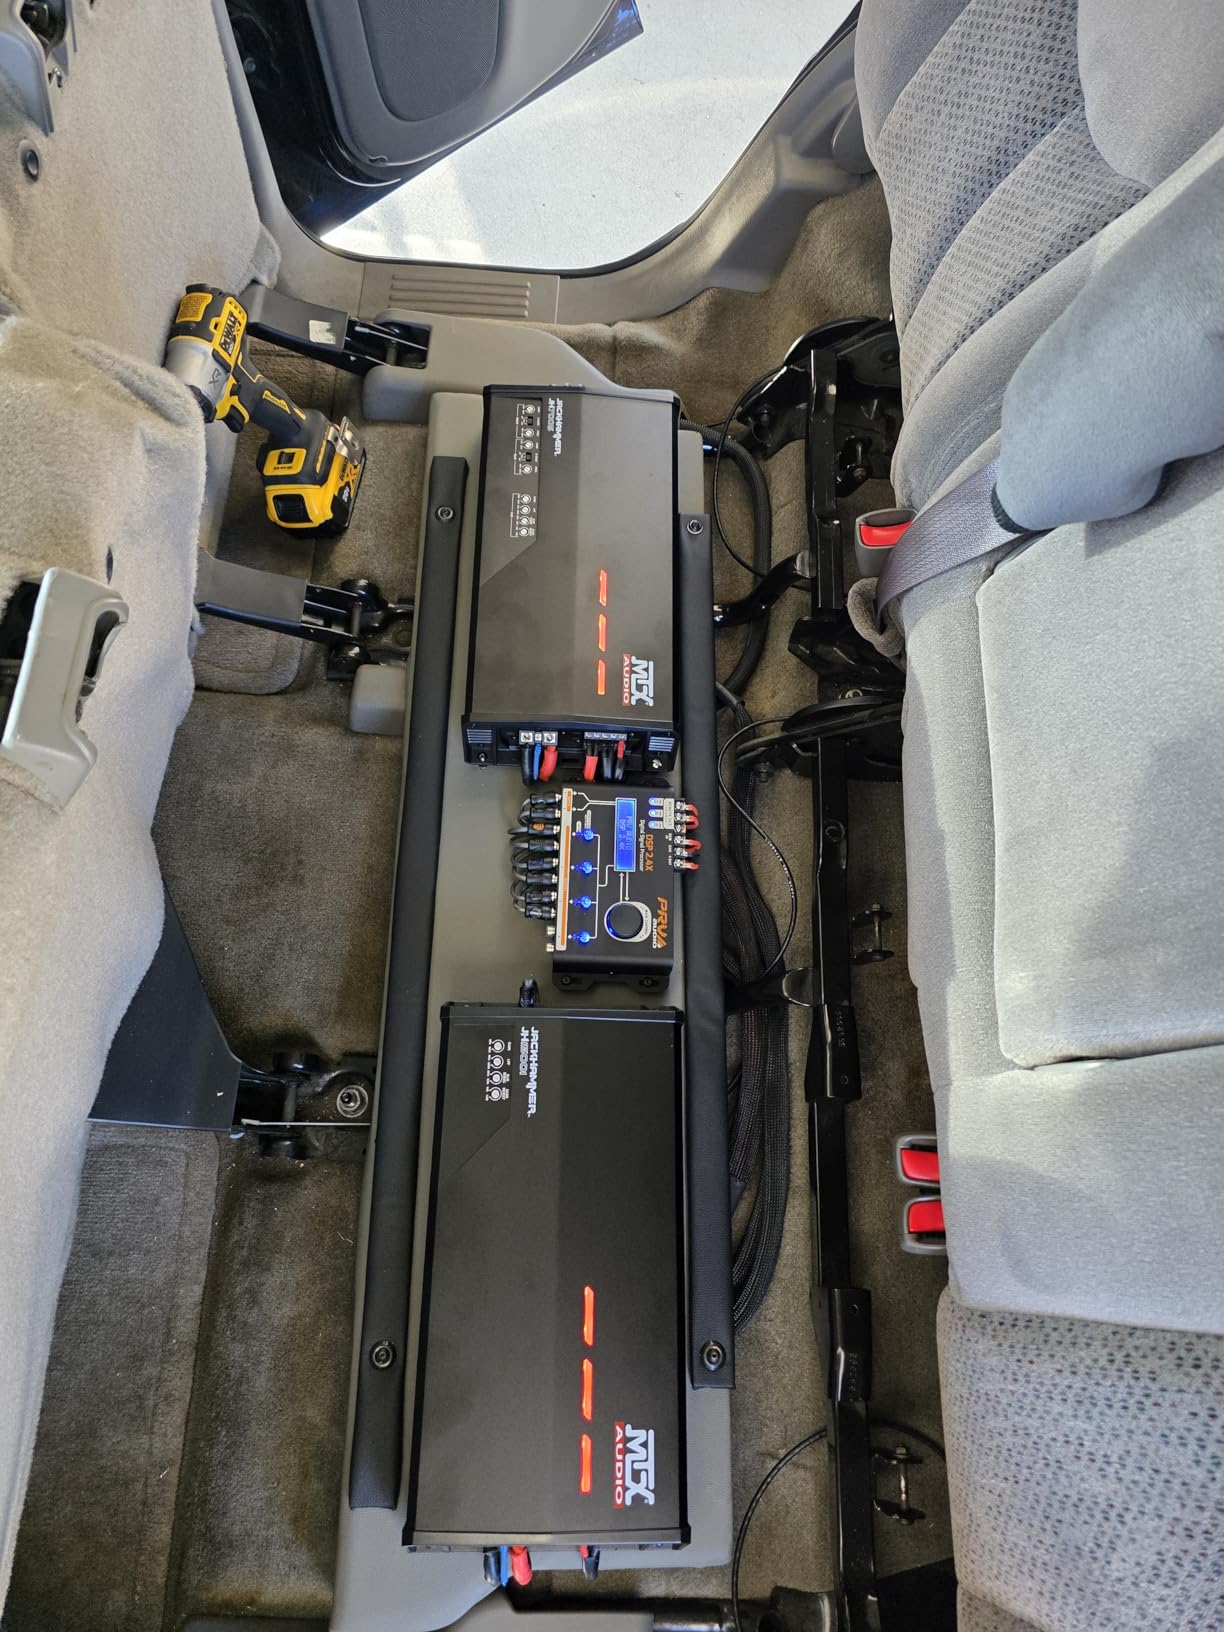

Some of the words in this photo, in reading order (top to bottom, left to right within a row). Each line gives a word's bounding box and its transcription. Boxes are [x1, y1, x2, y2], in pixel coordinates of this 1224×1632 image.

[553, 397, 563, 456] JACKHAMMER
[631, 656, 654, 707] MTX
[645, 834, 654, 850] DSP
[645, 852, 653, 872] 2.4X
[525, 1026, 539, 1114] JACKHAMMER
[615, 1425, 623, 1505] AUDIO
[625, 1424, 655, 1506] MTX
